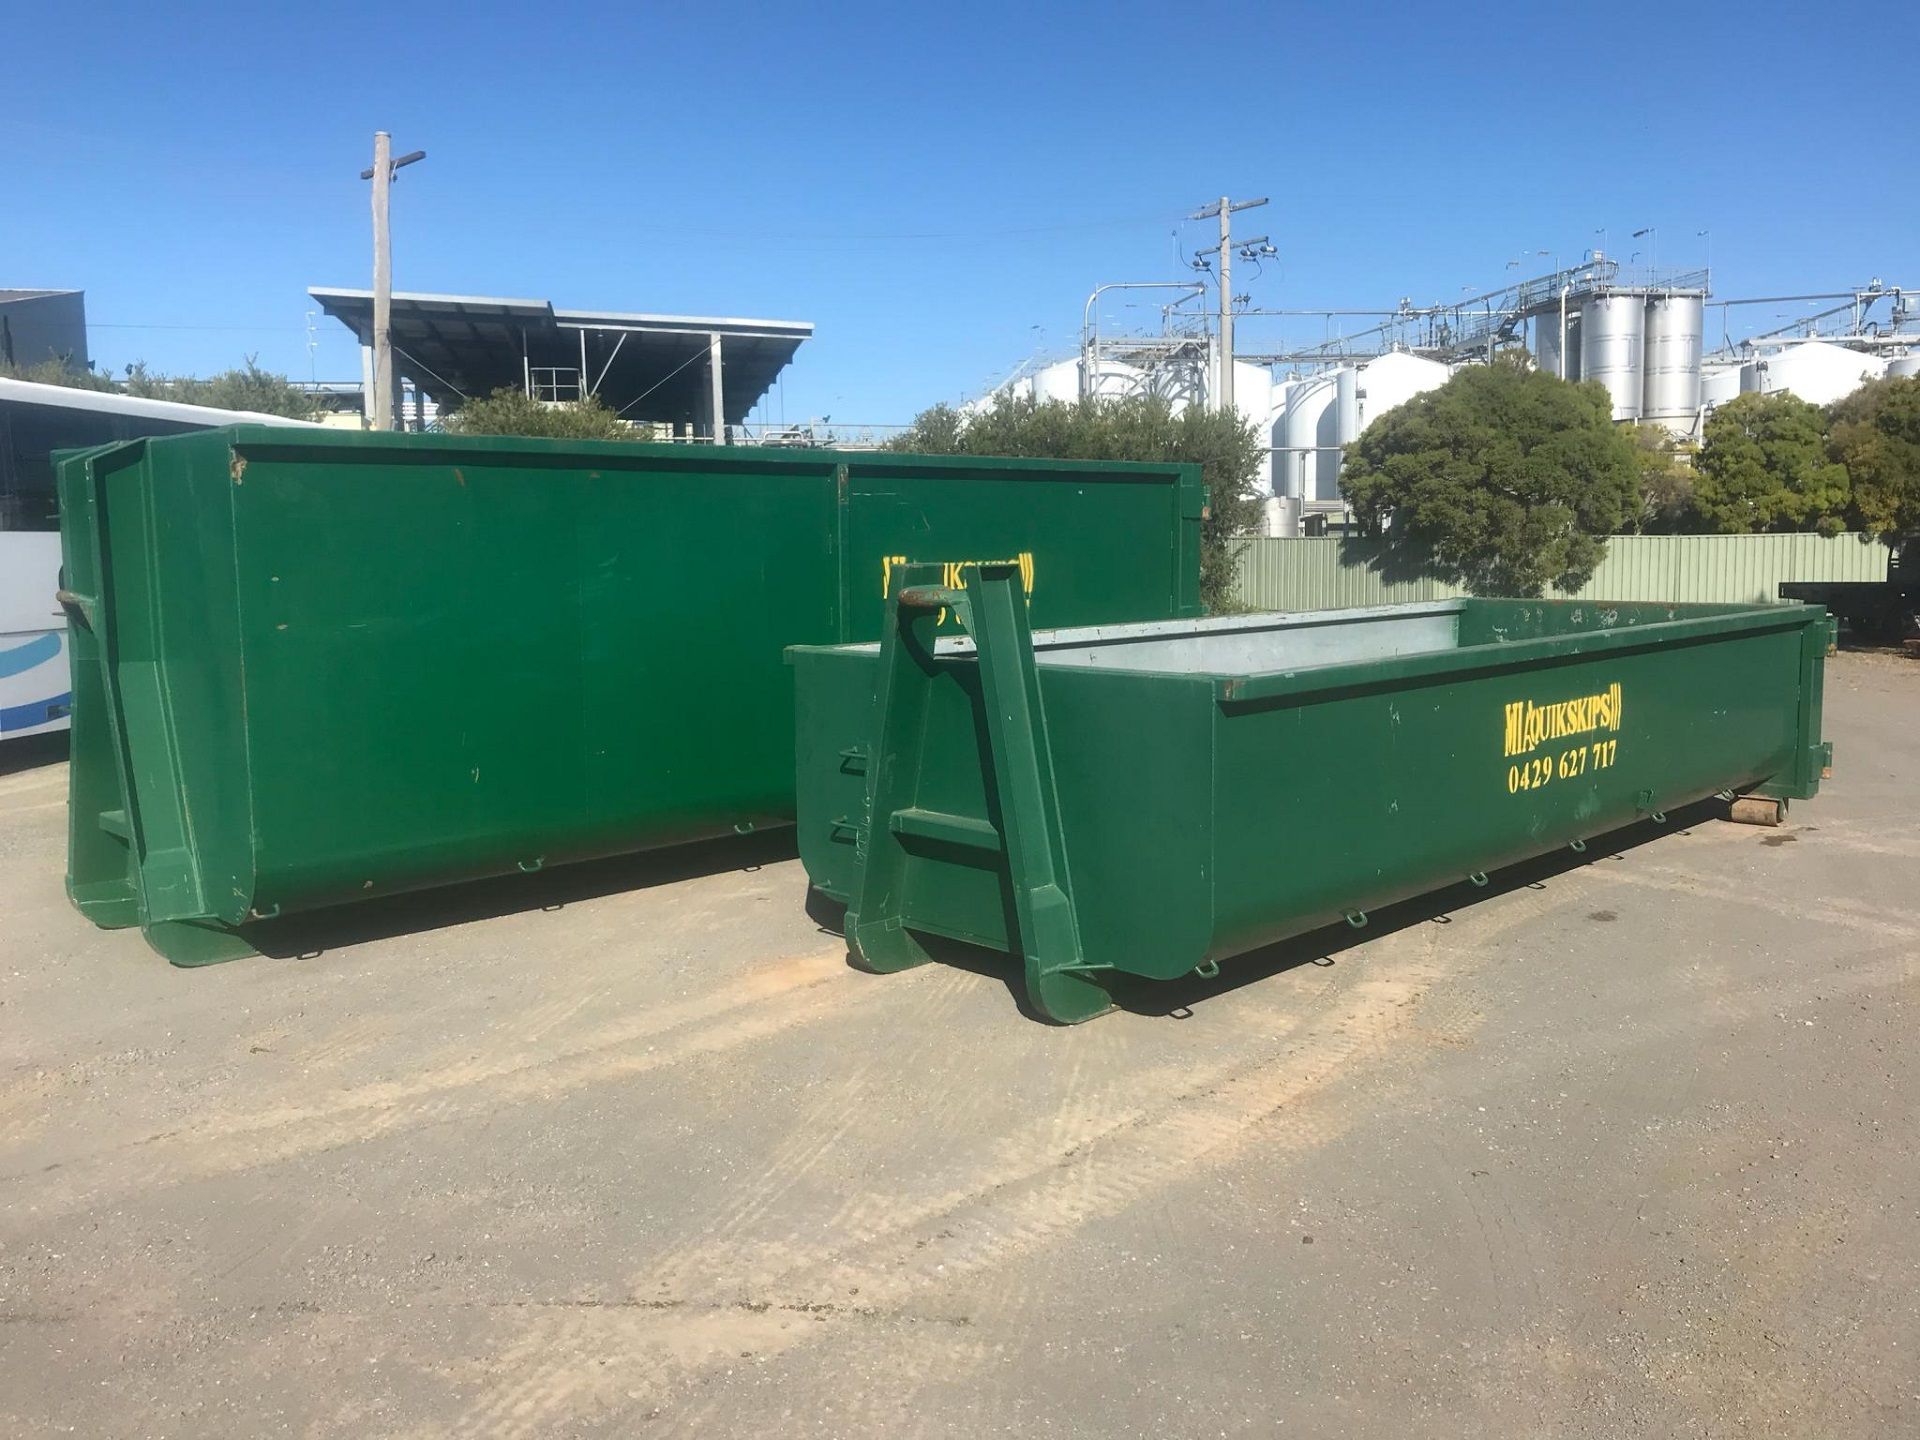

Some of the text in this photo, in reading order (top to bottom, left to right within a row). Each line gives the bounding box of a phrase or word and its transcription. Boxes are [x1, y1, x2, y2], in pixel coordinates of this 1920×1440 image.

[1508, 739, 1617, 794] 0429 627 717
